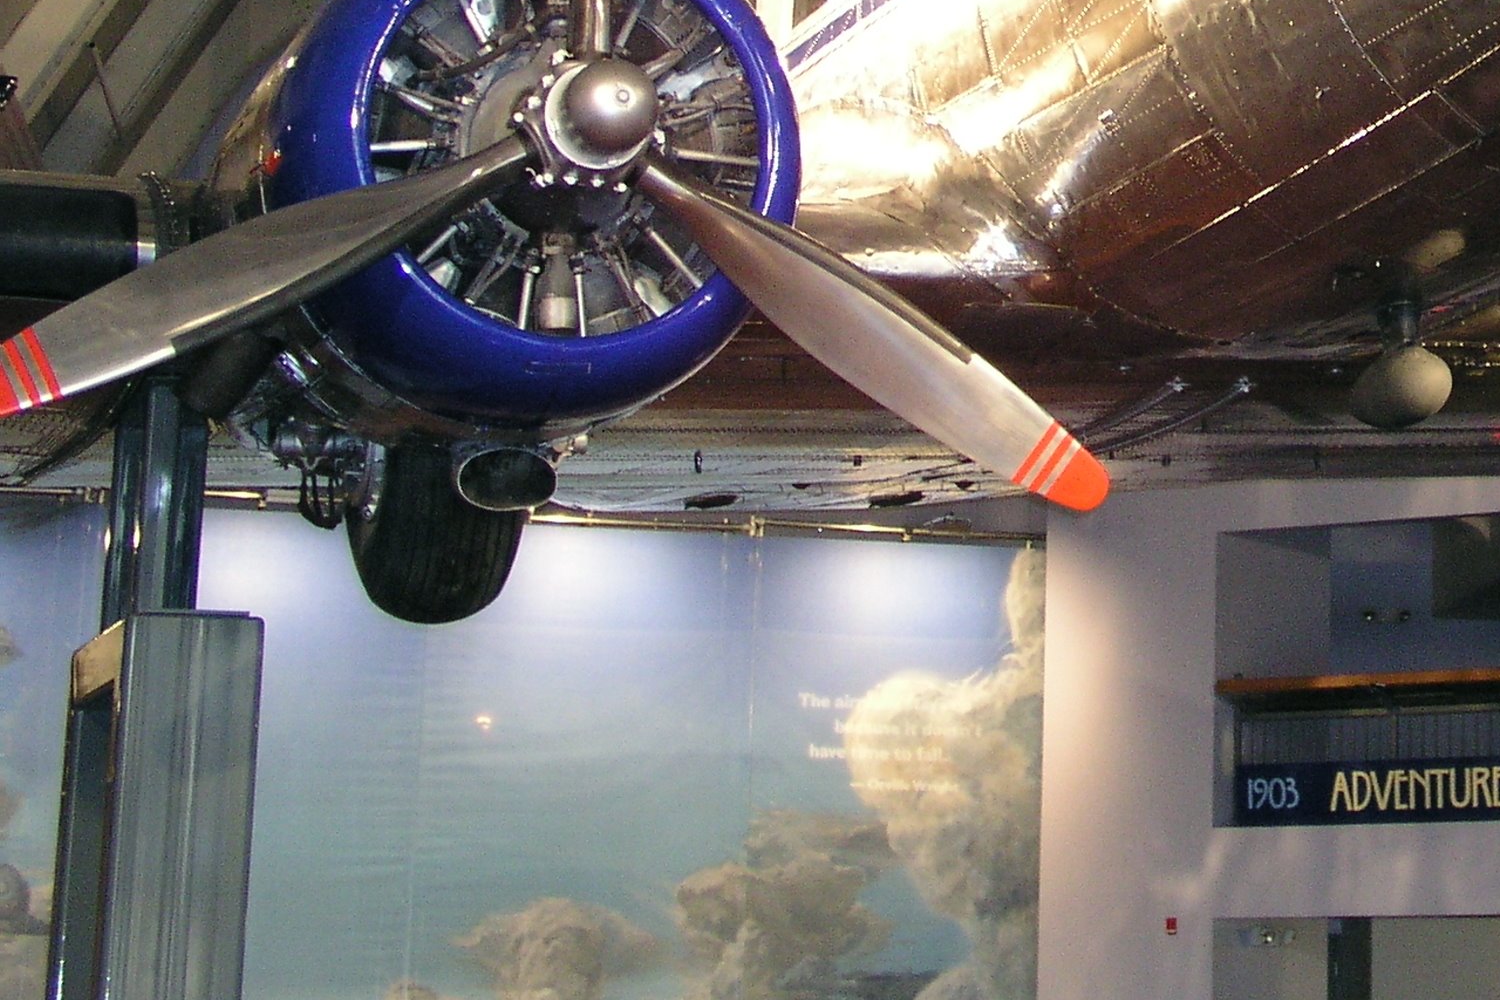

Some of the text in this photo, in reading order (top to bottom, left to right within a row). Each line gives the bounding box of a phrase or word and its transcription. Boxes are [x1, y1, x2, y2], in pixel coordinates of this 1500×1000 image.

[798, 692, 831, 709] The
[809, 743, 846, 760] have
[1248, 777, 1299, 810] 1903
